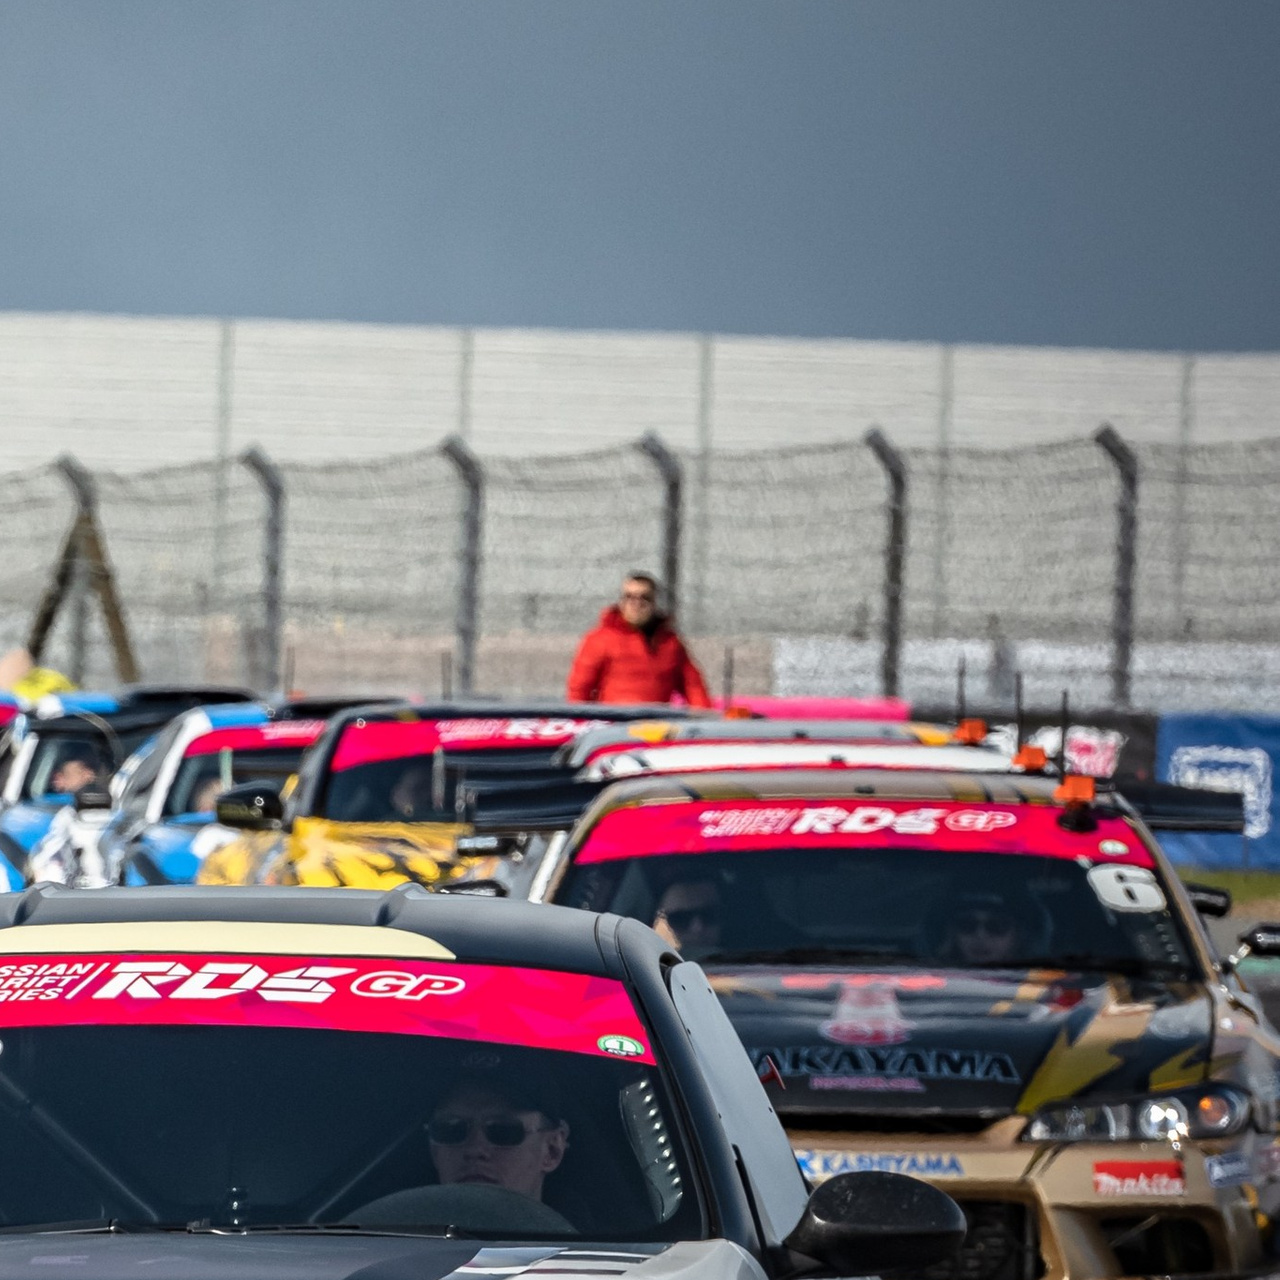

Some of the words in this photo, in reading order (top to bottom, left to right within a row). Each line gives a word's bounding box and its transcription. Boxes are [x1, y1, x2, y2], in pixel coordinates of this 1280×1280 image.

[790, 806, 951, 835] RDS
[1086, 863, 1168, 914] 6
[91, 961, 358, 1003] RDS
[351, 970, 466, 1001] GP
